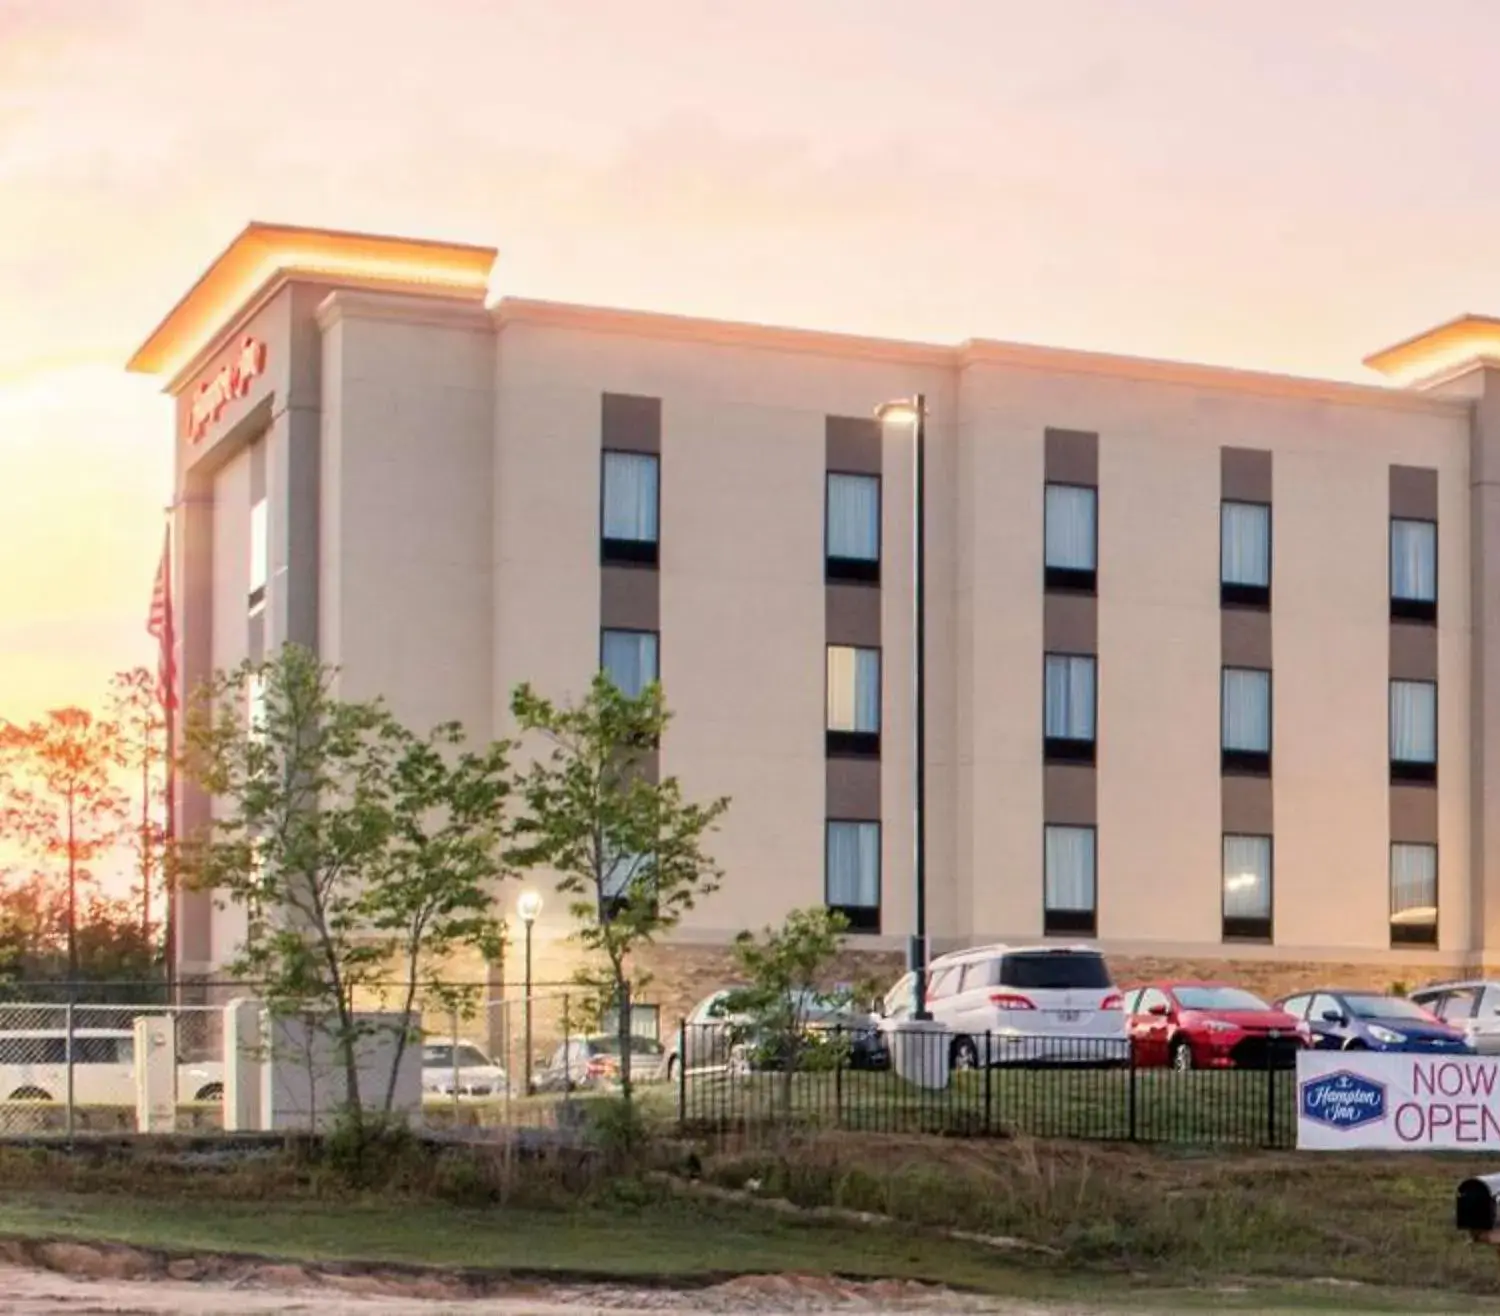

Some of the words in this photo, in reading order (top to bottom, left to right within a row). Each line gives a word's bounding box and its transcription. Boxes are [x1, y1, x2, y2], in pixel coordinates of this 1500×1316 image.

[1412, 1061, 1498, 1097] NOW
[1307, 1085, 1381, 1108] Hampton
[1324, 1103, 1361, 1121] Inn
